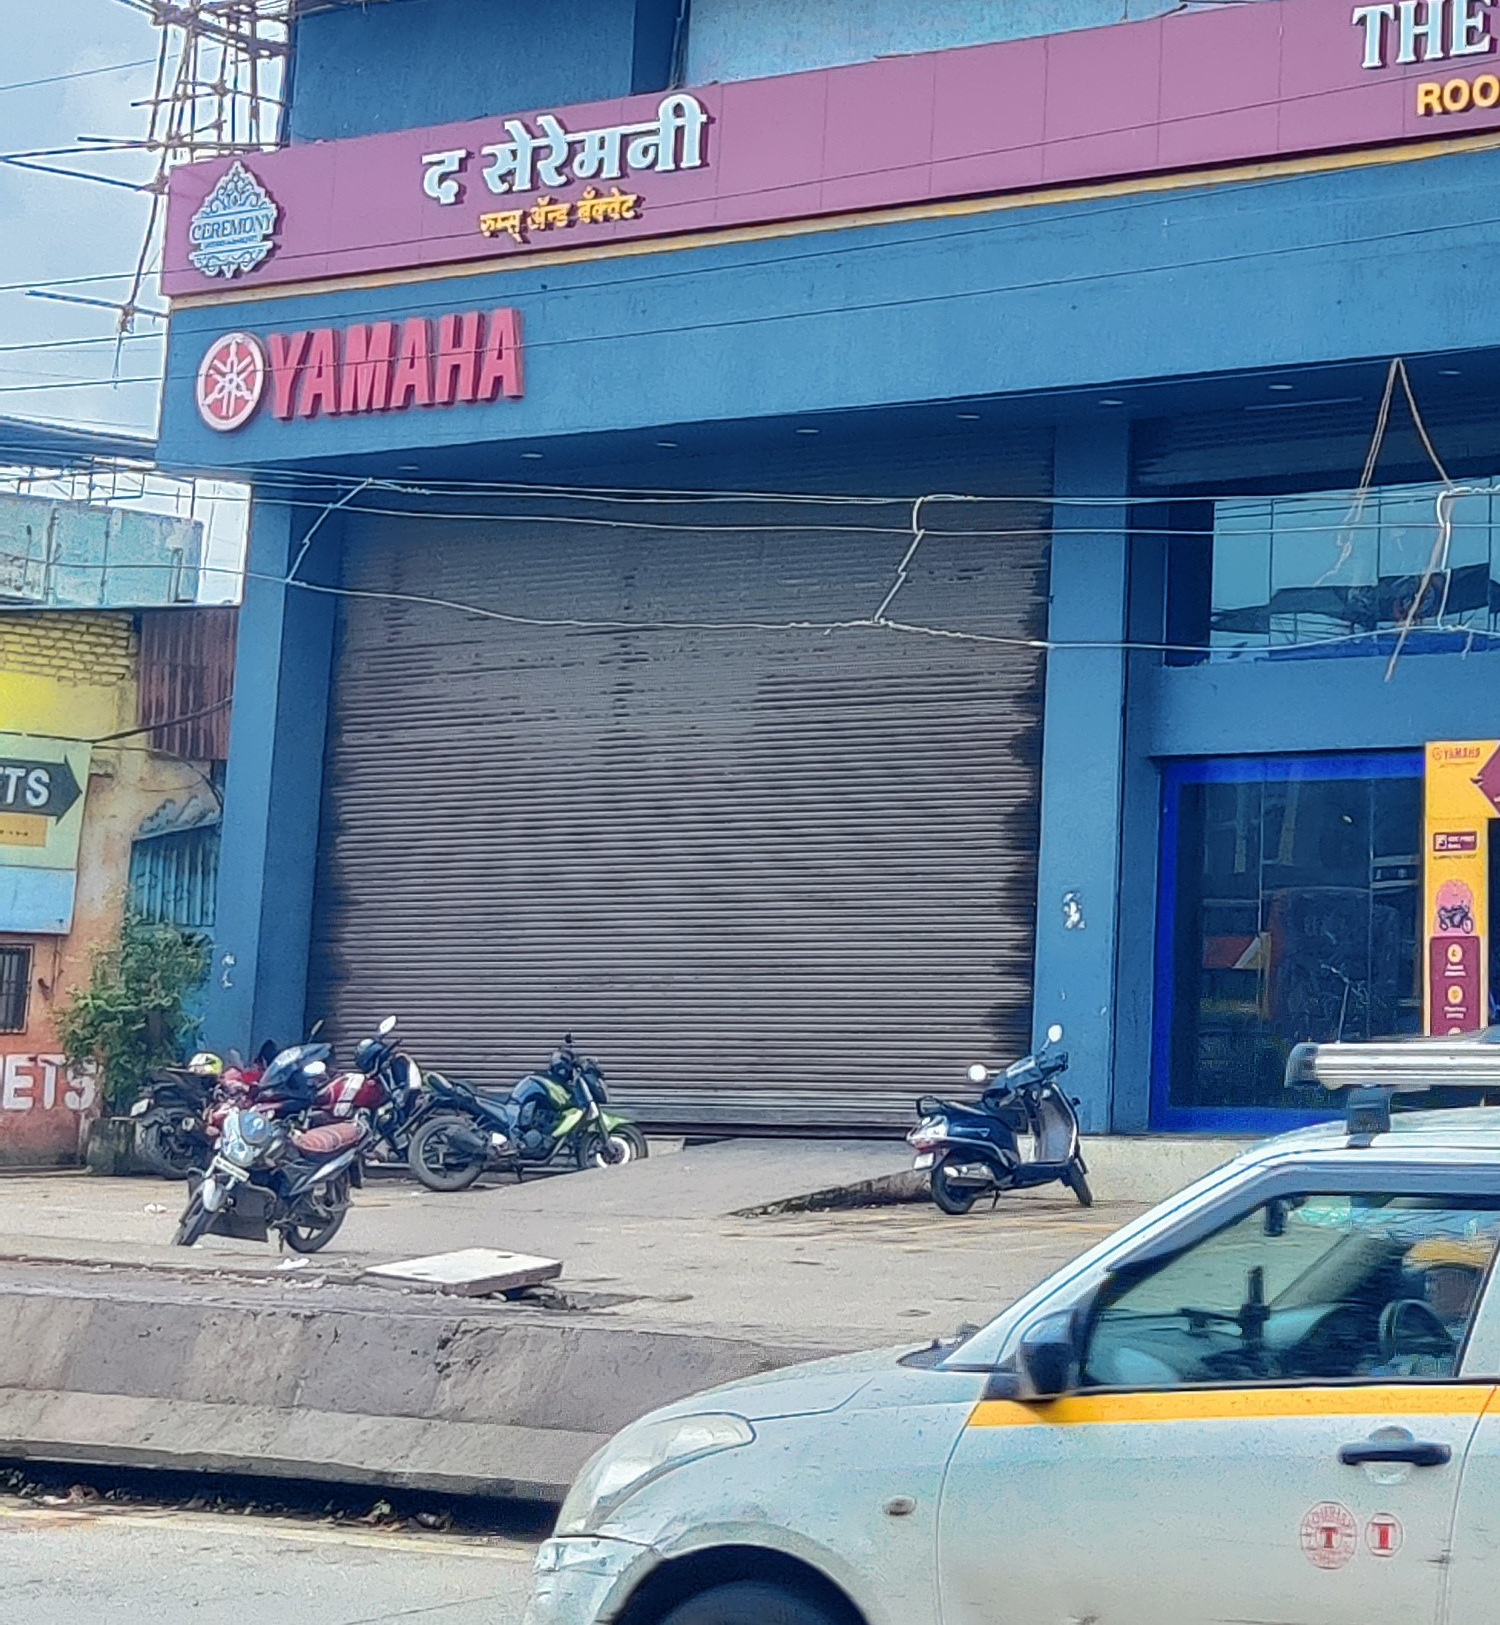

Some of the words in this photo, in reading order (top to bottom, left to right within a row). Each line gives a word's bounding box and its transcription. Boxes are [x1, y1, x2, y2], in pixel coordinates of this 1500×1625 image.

[421, 149, 467, 205] द
[481, 93, 708, 195] सेरेमनी
[191, 212, 274, 242] CEREMONY
[267, 307, 525, 420] YAMAHA
[0, 766, 50, 807] TS
